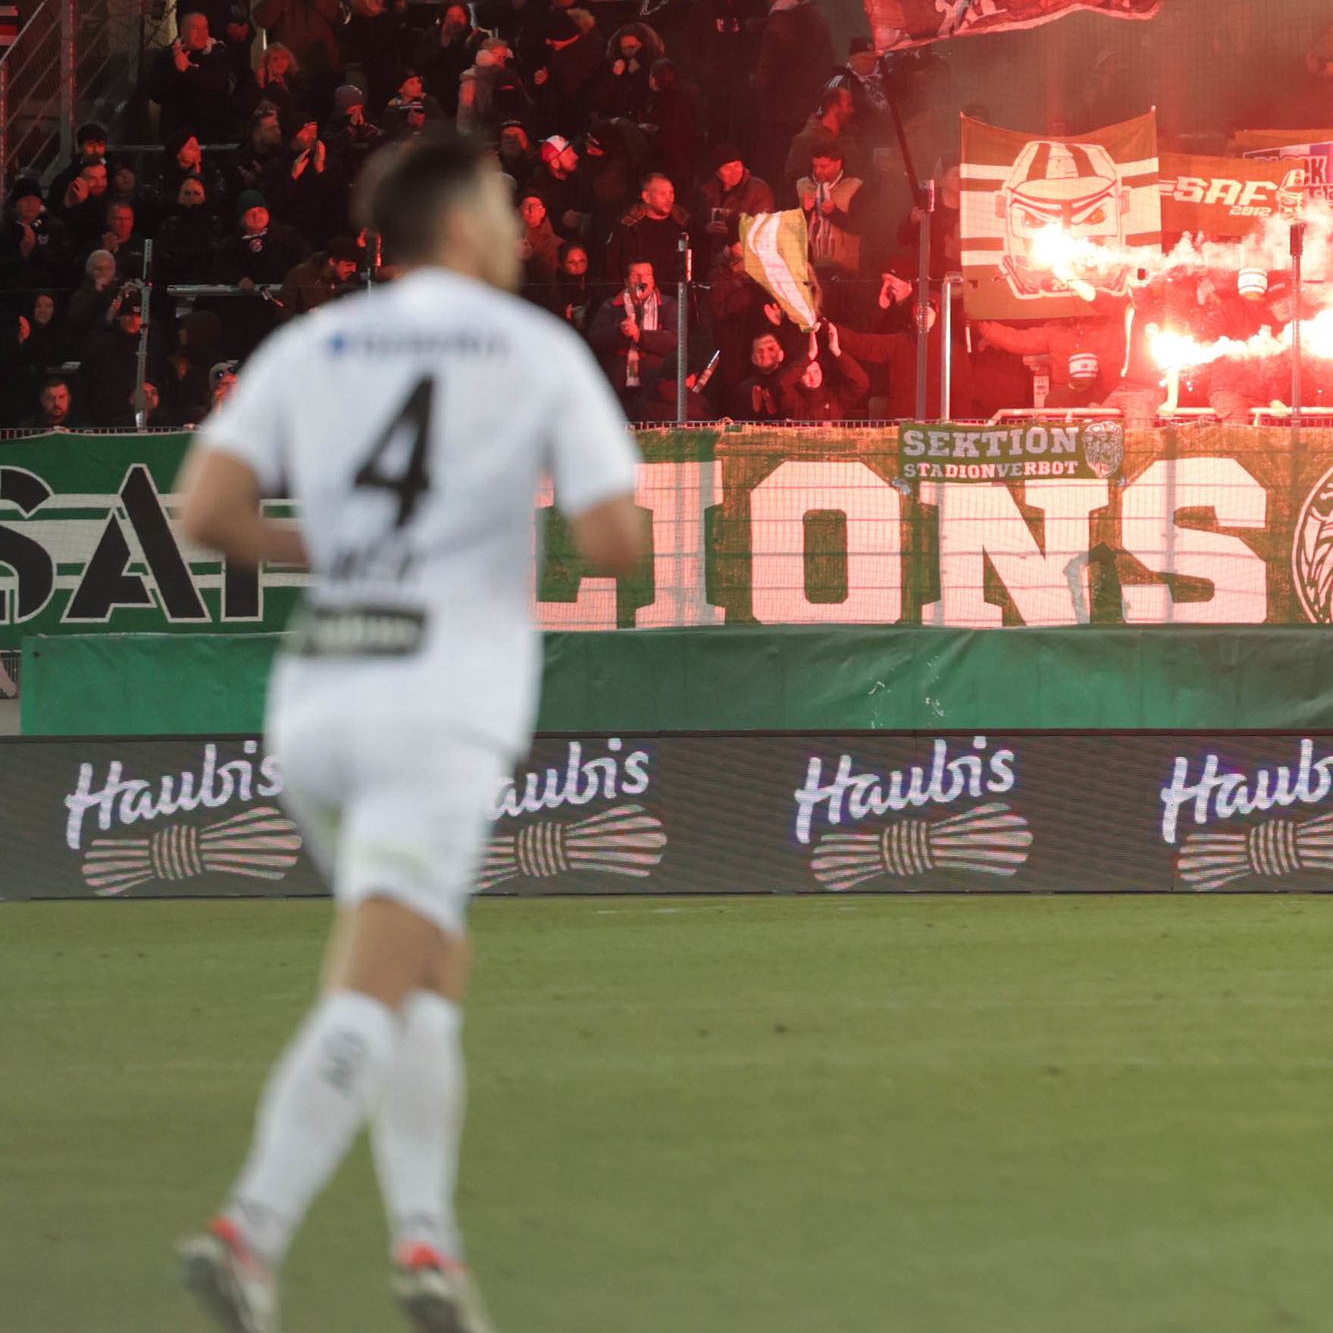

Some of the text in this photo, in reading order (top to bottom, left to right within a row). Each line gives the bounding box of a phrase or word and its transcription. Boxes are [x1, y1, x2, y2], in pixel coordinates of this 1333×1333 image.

[1172, 175, 1279, 207] SAF
[1228, 205, 1273, 218] 2012
[354, 373, 440, 529] 4
[903, 426, 1079, 458] SEKTION
[903, 460, 1079, 480] STADIONVERBOT
[64, 740, 284, 850] Haubis
[490, 737, 650, 821] aubis
[795, 736, 1015, 844] Haubis
